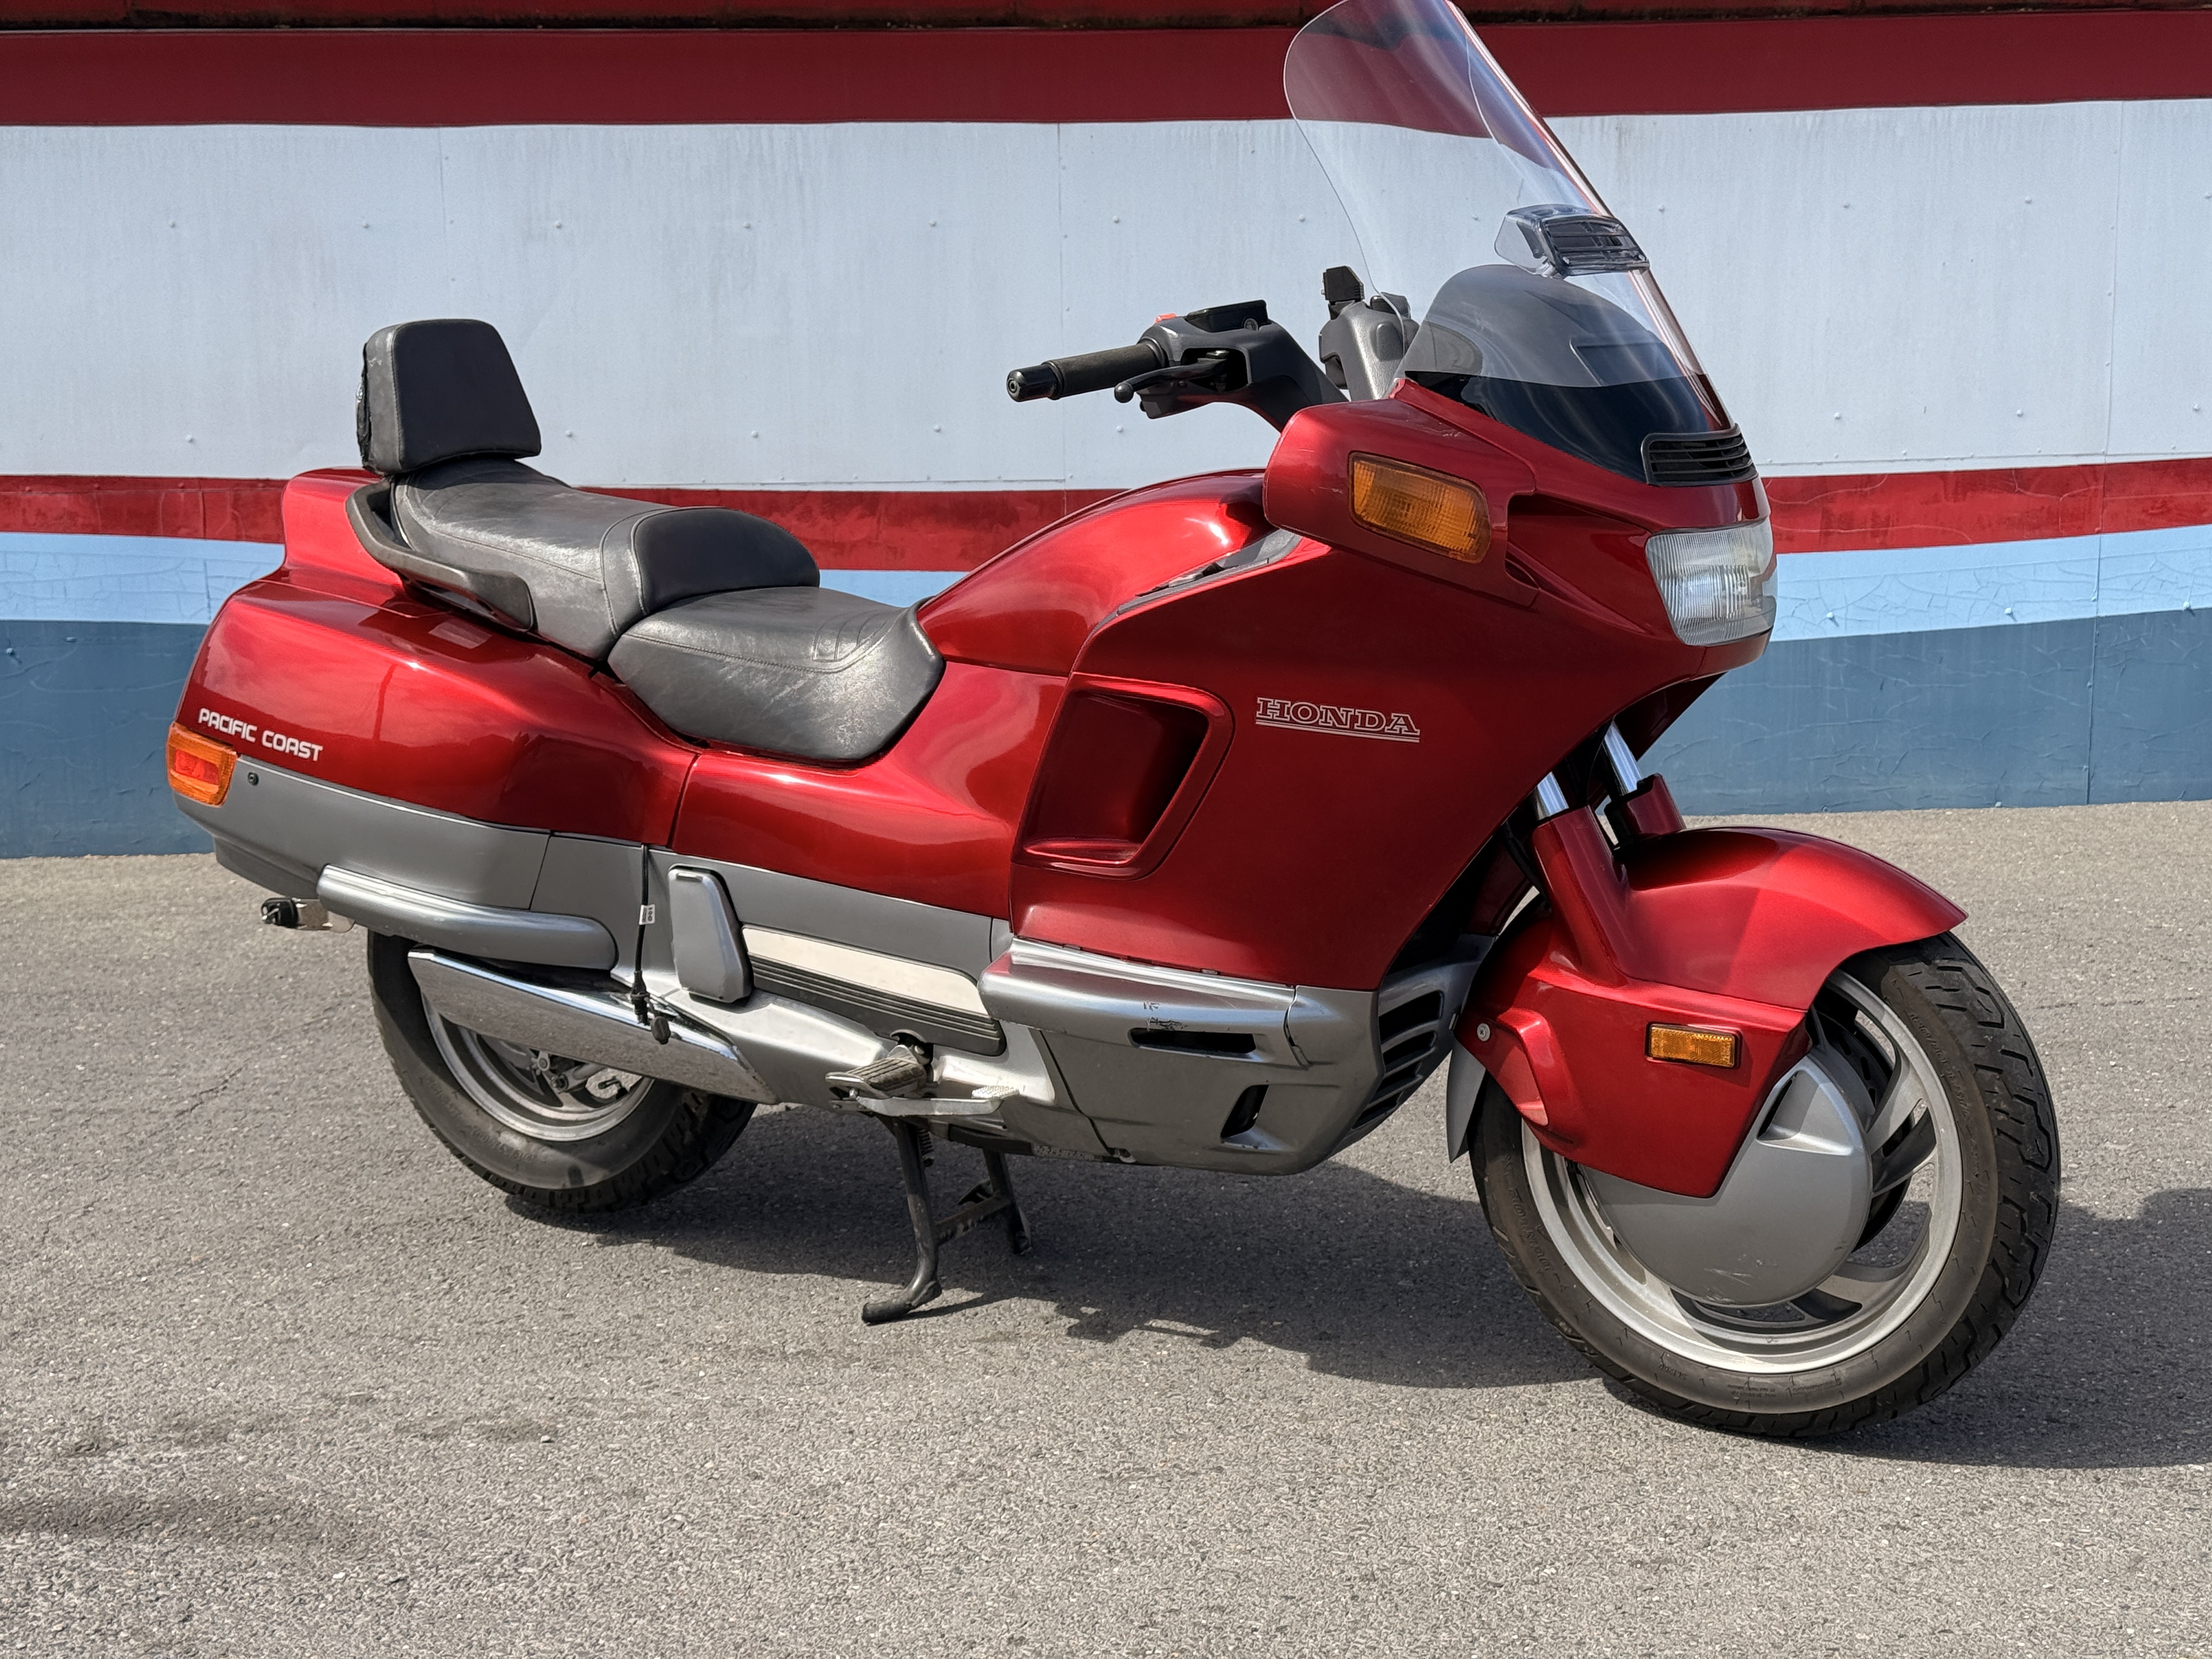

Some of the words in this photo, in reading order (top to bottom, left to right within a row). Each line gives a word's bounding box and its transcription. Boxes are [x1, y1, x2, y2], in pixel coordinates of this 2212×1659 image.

[198, 708, 258, 743] PACIFIC
[261, 730, 324, 761] COAST
[1256, 696, 1420, 736] HONDA
